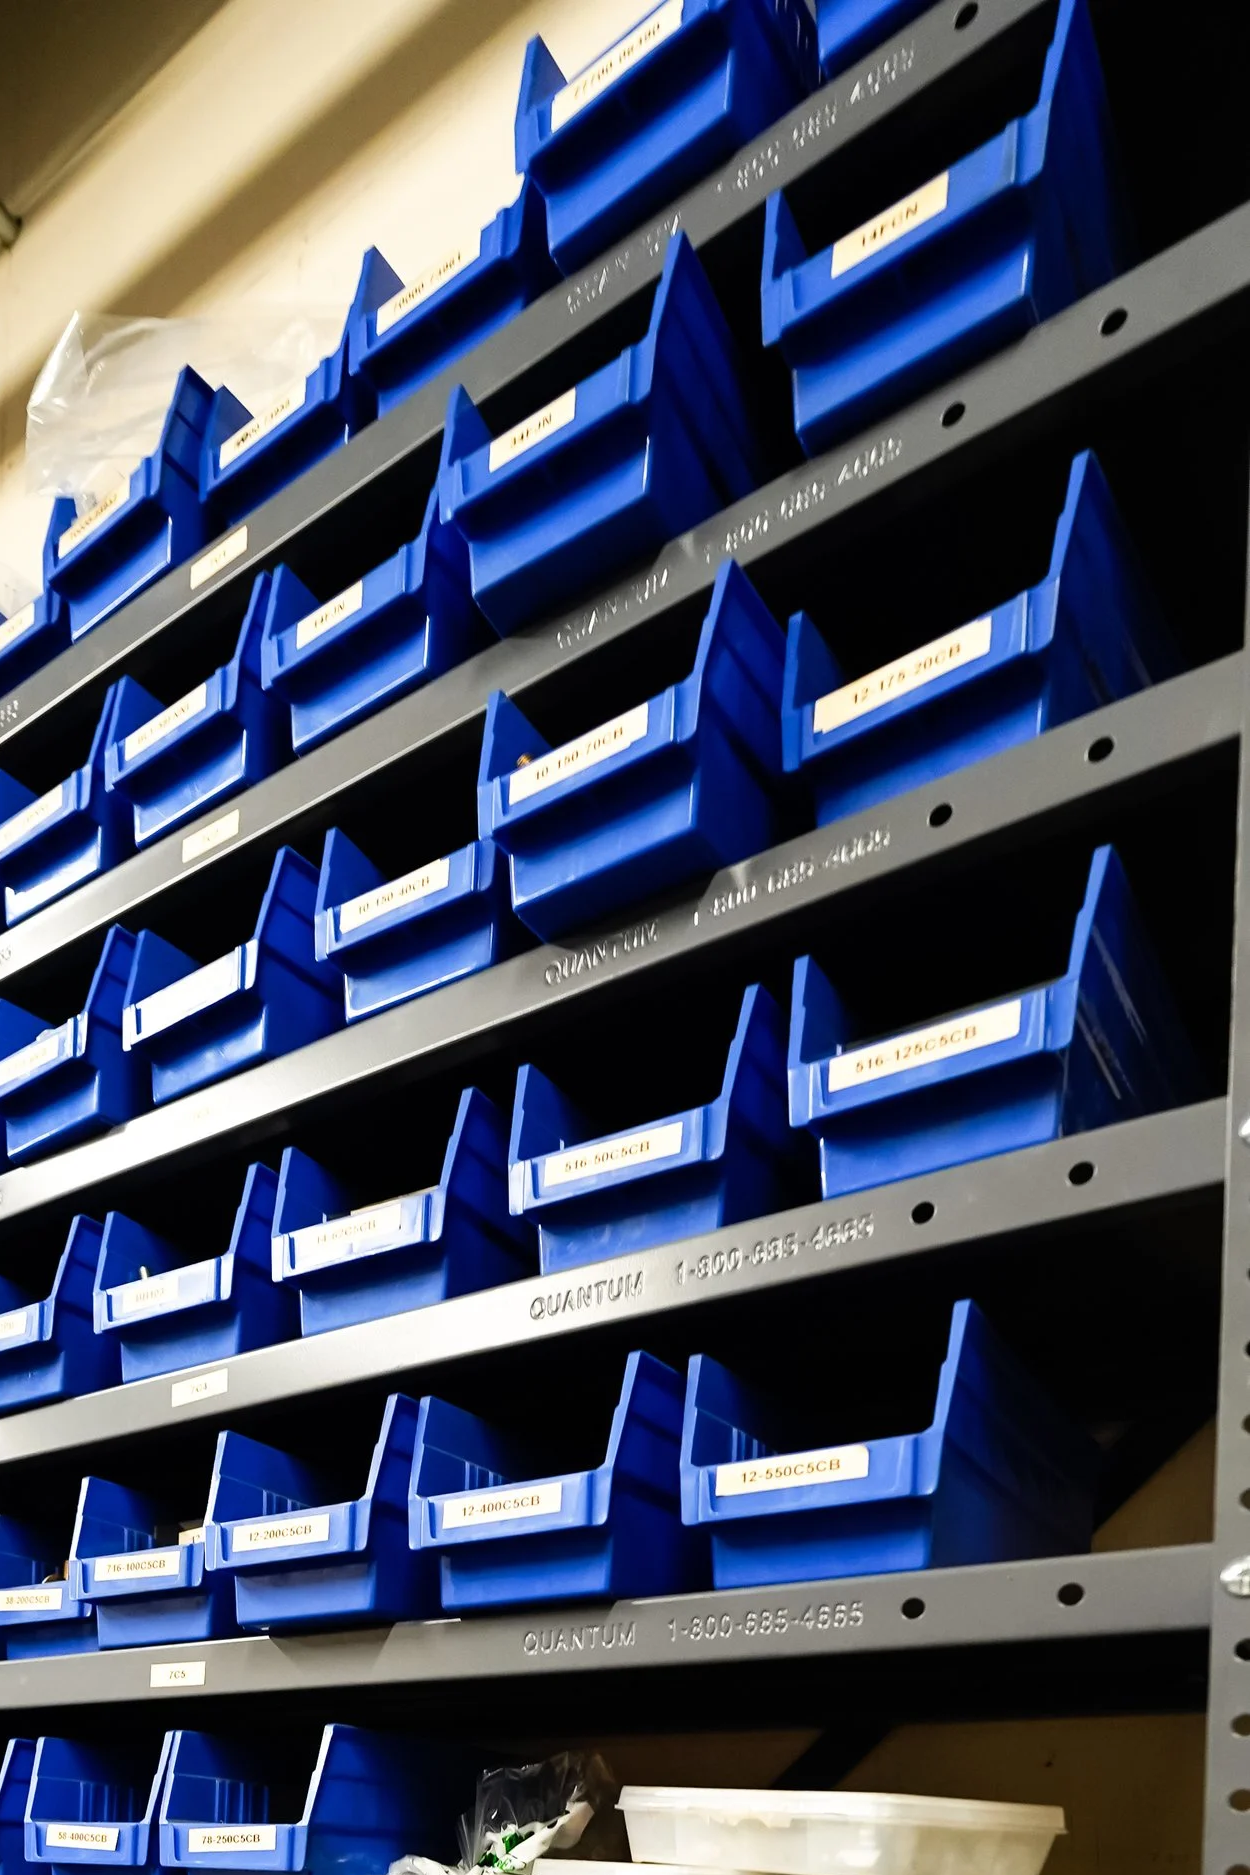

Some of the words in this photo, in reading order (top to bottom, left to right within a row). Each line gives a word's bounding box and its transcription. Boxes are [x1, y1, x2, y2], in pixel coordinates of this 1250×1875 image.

[529, 1271, 645, 1320] QUANTUM
[739, 1457, 841, 1483] 12-550C5CB
[460, 1492, 541, 1518] 12-400C5CB
[248, 1523, 312, 1541] 12-200C5CB
[105, 1557, 167, 1578] 716-100C5CB
[523, 1622, 637, 1655] QUANTUM
[667, 1603, 864, 1643] 1-800-685-4665
[167, 1668, 187, 1680] 7C5
[200, 1832, 261, 1846] 78-250C5CB
